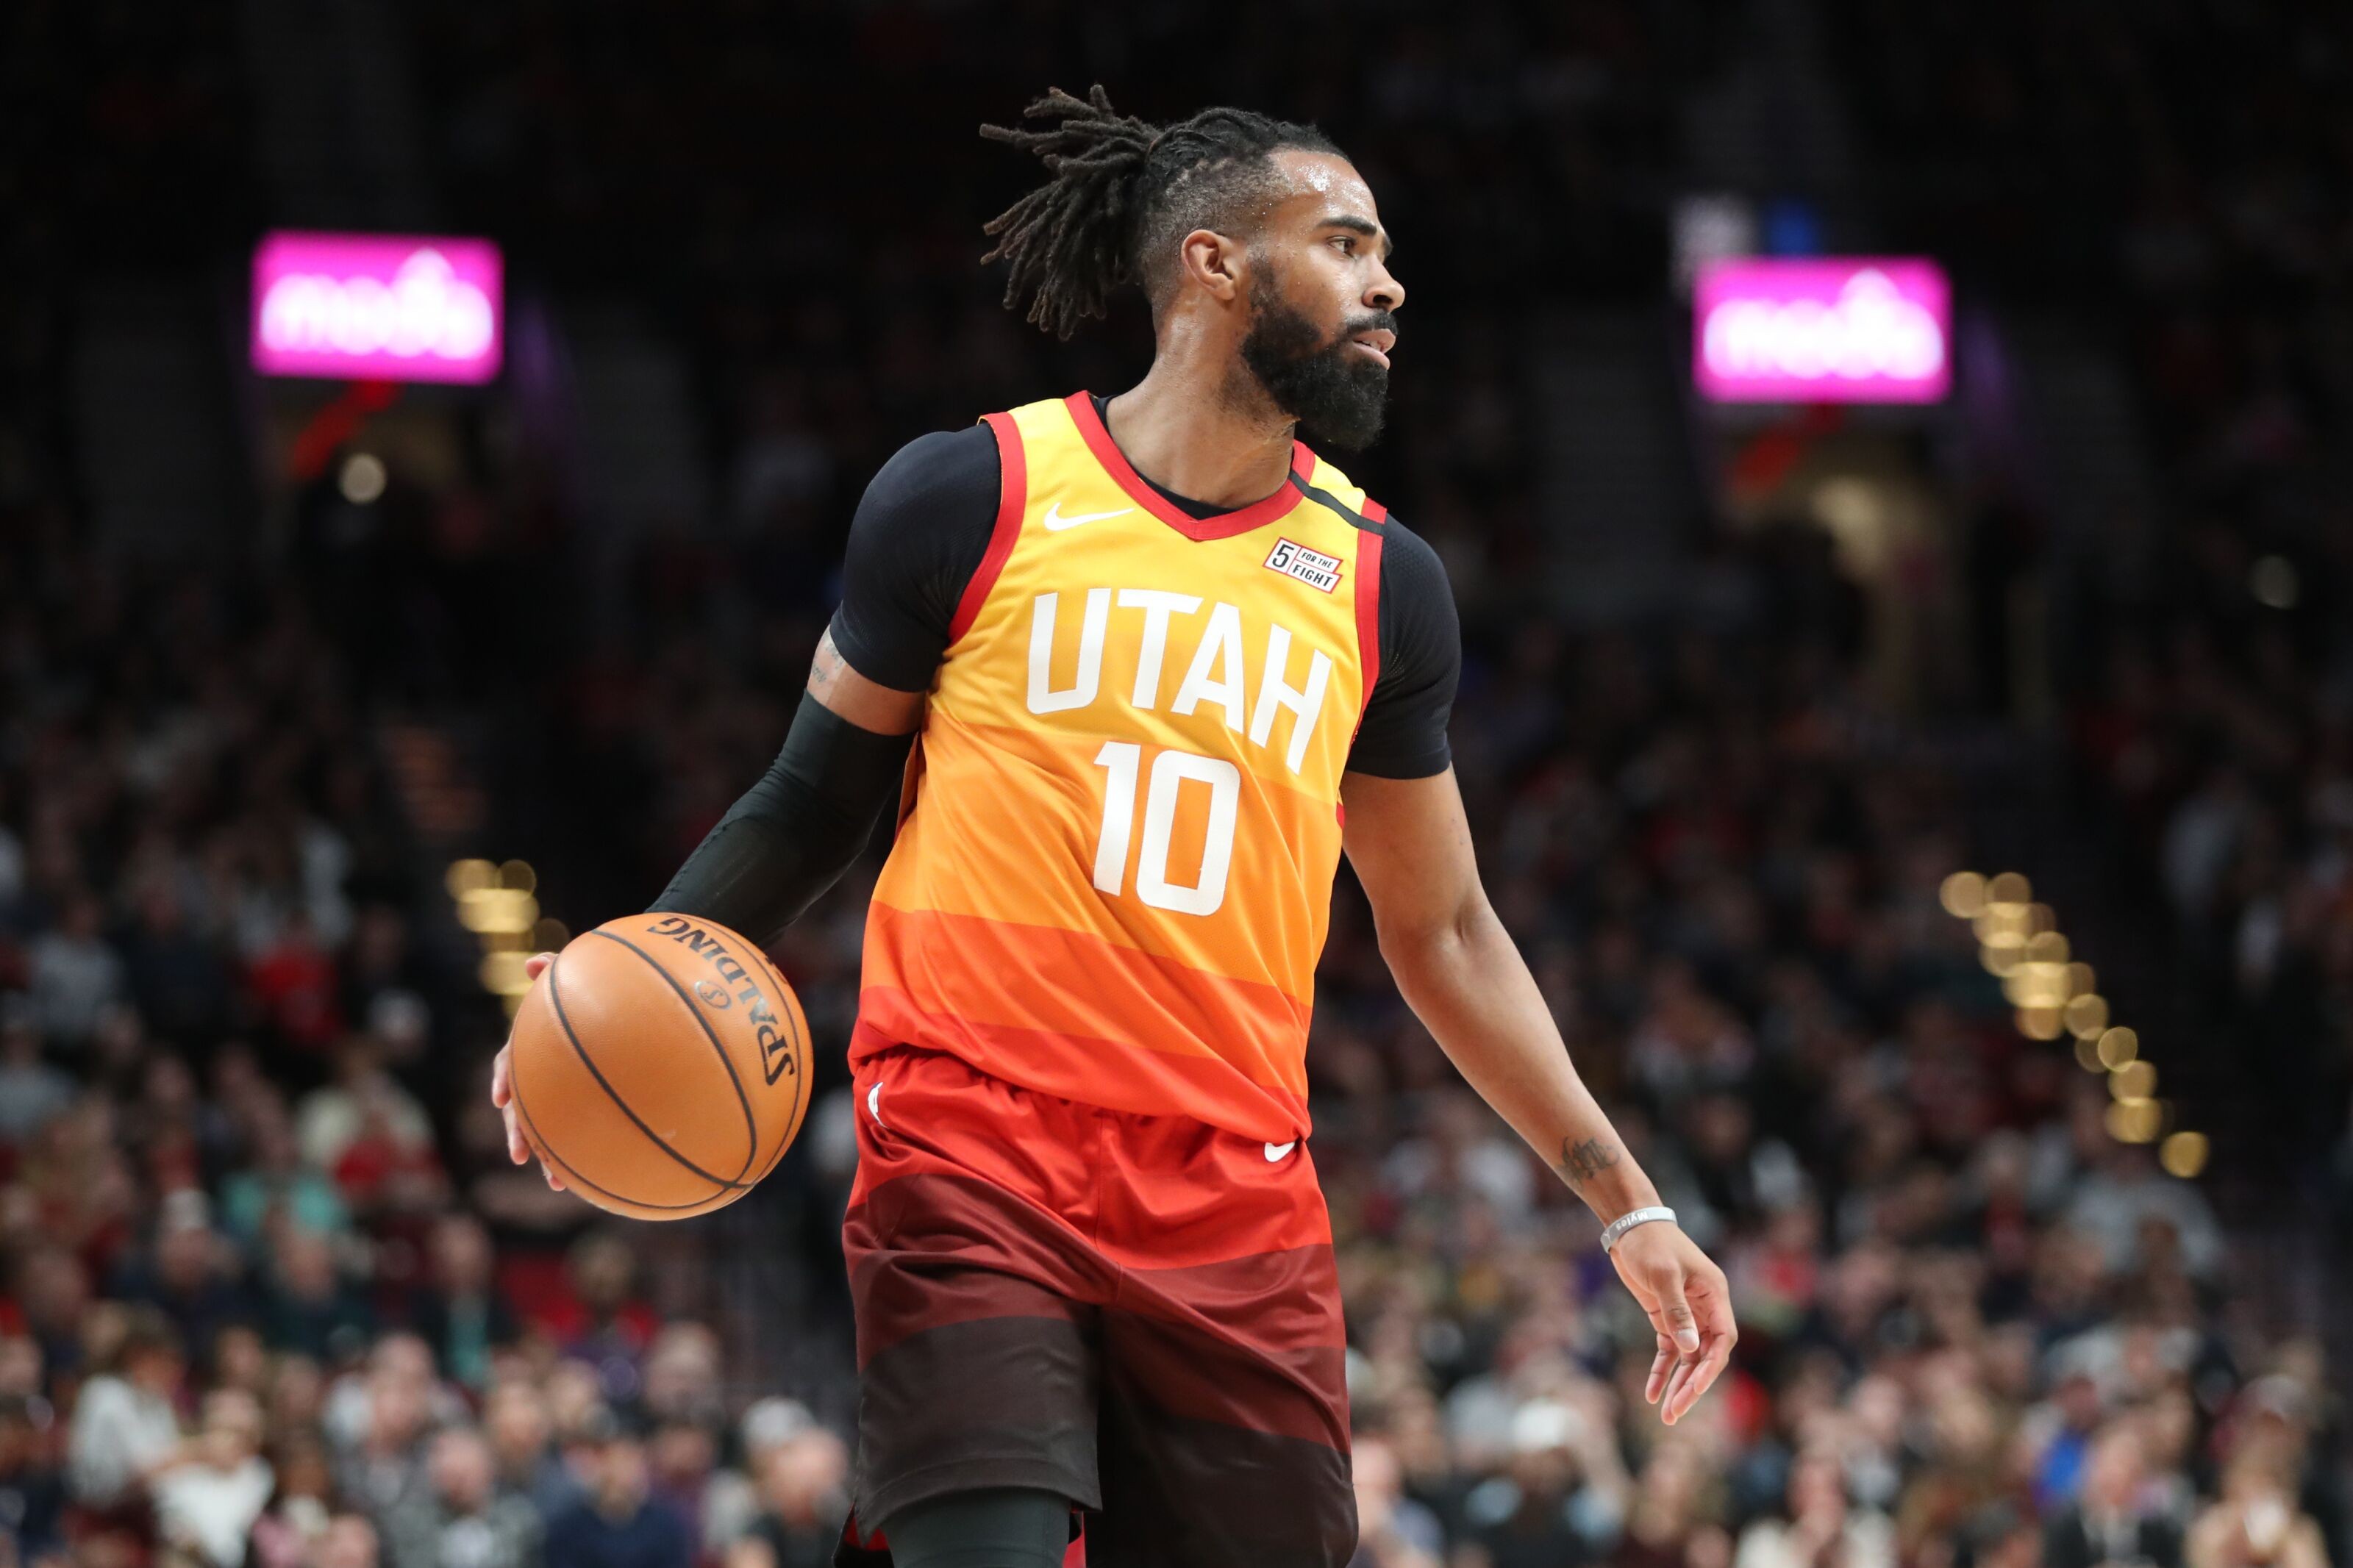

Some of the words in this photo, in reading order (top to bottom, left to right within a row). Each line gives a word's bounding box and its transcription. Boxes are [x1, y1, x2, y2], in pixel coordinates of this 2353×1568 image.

[1272, 544, 1294, 568] 5
[1302, 552, 1317, 562] FOR
[1318, 559, 1333, 568] THE
[1293, 565, 1332, 587] FIGHT
[1027, 587, 1332, 776] UTAH
[1093, 741, 1240, 916] 10
[647, 917, 795, 1086] SPALDING
[1615, 1211, 1648, 1231] Myles
